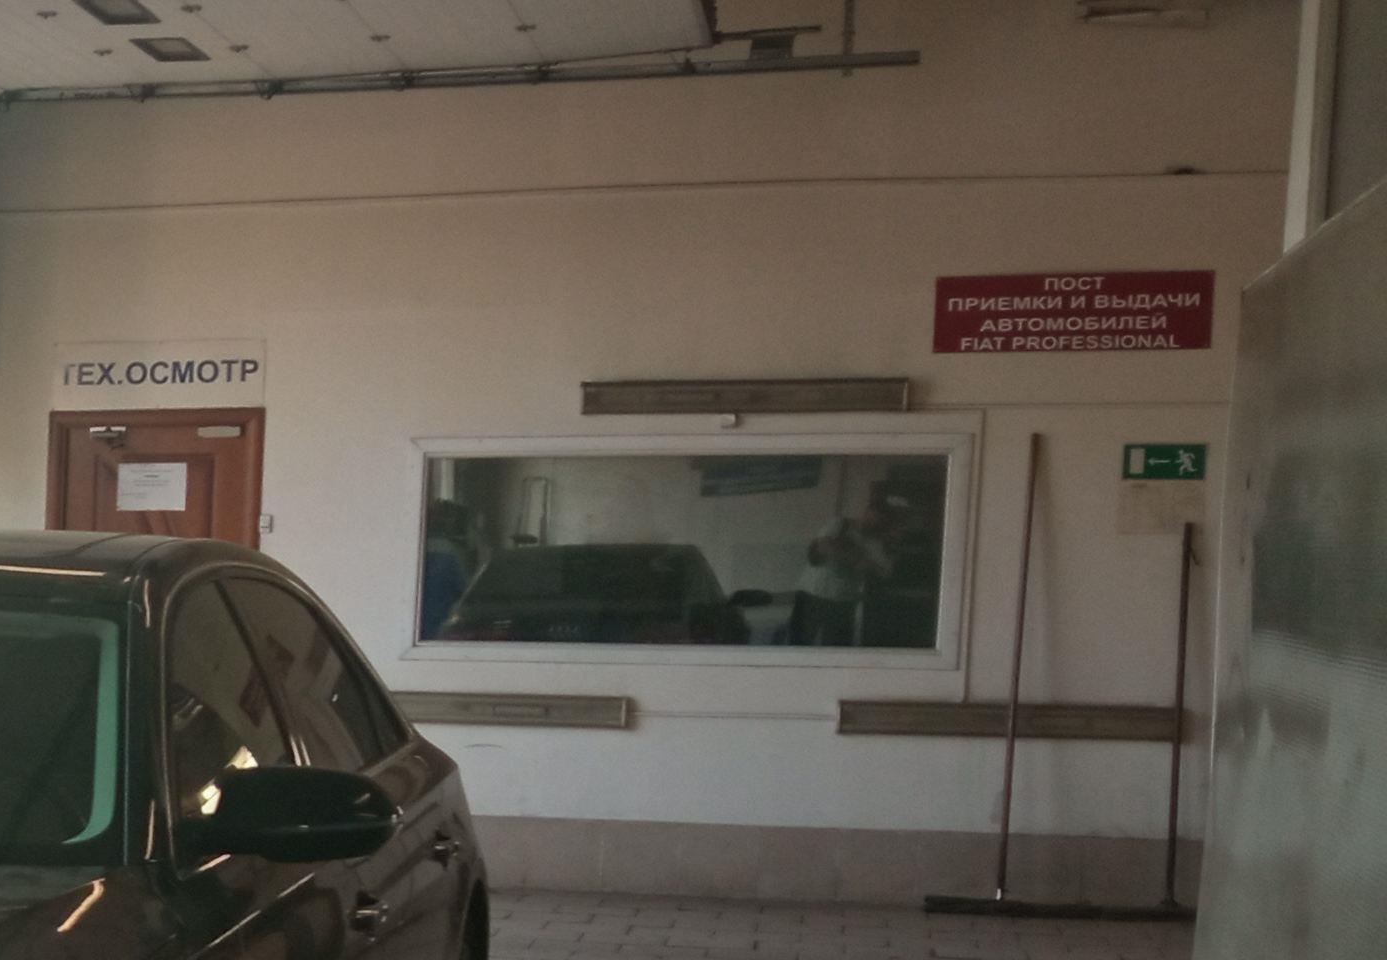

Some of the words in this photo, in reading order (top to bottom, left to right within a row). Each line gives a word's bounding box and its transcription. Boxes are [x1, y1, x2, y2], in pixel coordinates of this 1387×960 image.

[1044, 276, 1105, 291] ПОСТ
[948, 296, 1063, 312] ПРИЕМКИ
[1070, 296, 1085, 309] И
[1094, 293, 1201, 310] ВЫДАЧИ
[979, 312, 1168, 332] АВТОМОБИЛЕЙ
[960, 336, 1006, 351] FIAT
[1011, 334, 1180, 351] PROFESSIONAL
